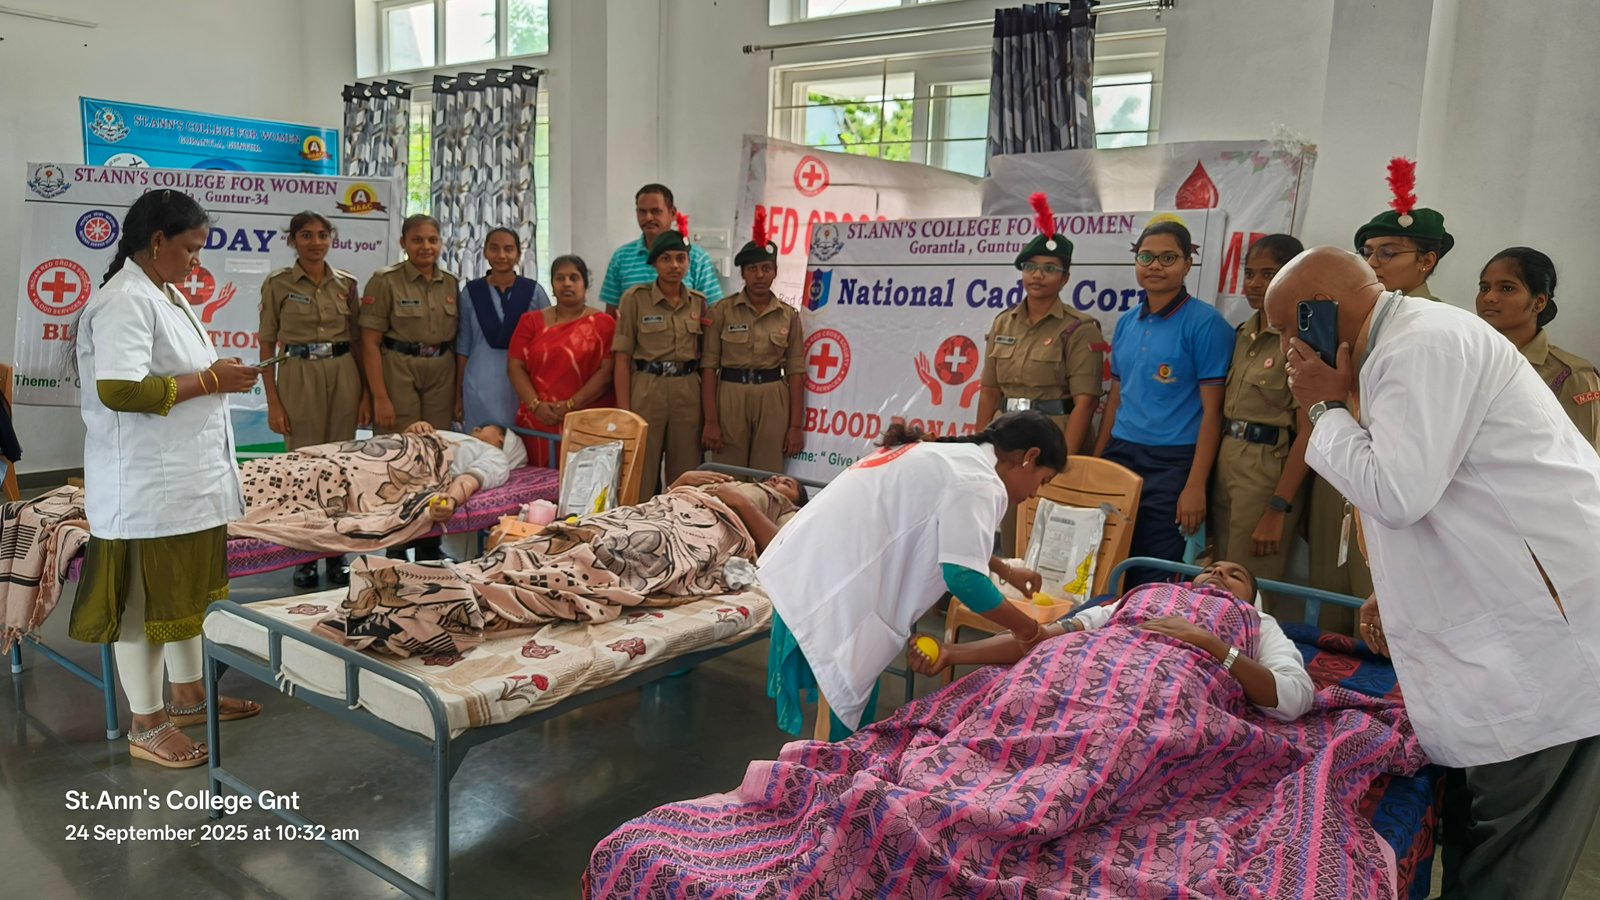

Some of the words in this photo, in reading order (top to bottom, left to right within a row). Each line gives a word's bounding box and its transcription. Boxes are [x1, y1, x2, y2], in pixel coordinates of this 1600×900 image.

[186, 122, 234, 137] COLLEGE
[237, 129, 258, 140] FOR
[261, 131, 301, 145] WOMEN
[153, 171, 226, 190] COLLEGE
[230, 176, 265, 192] FOR
[270, 178, 338, 195] WOMEN
[205, 191, 269, 205] Guntur-34
[921, 218, 1002, 239] COLLEGE
[1054, 215, 1136, 235] WOMEN
[203, 227, 277, 252] DAY
[332, 238, 352, 251] But
[909, 240, 965, 255] Gorantla
[837, 277, 955, 307] National
[966, 278, 1024, 309] Cad
[14, 374, 61, 388] Theme:
[803, 407, 882, 440] BLOOD
